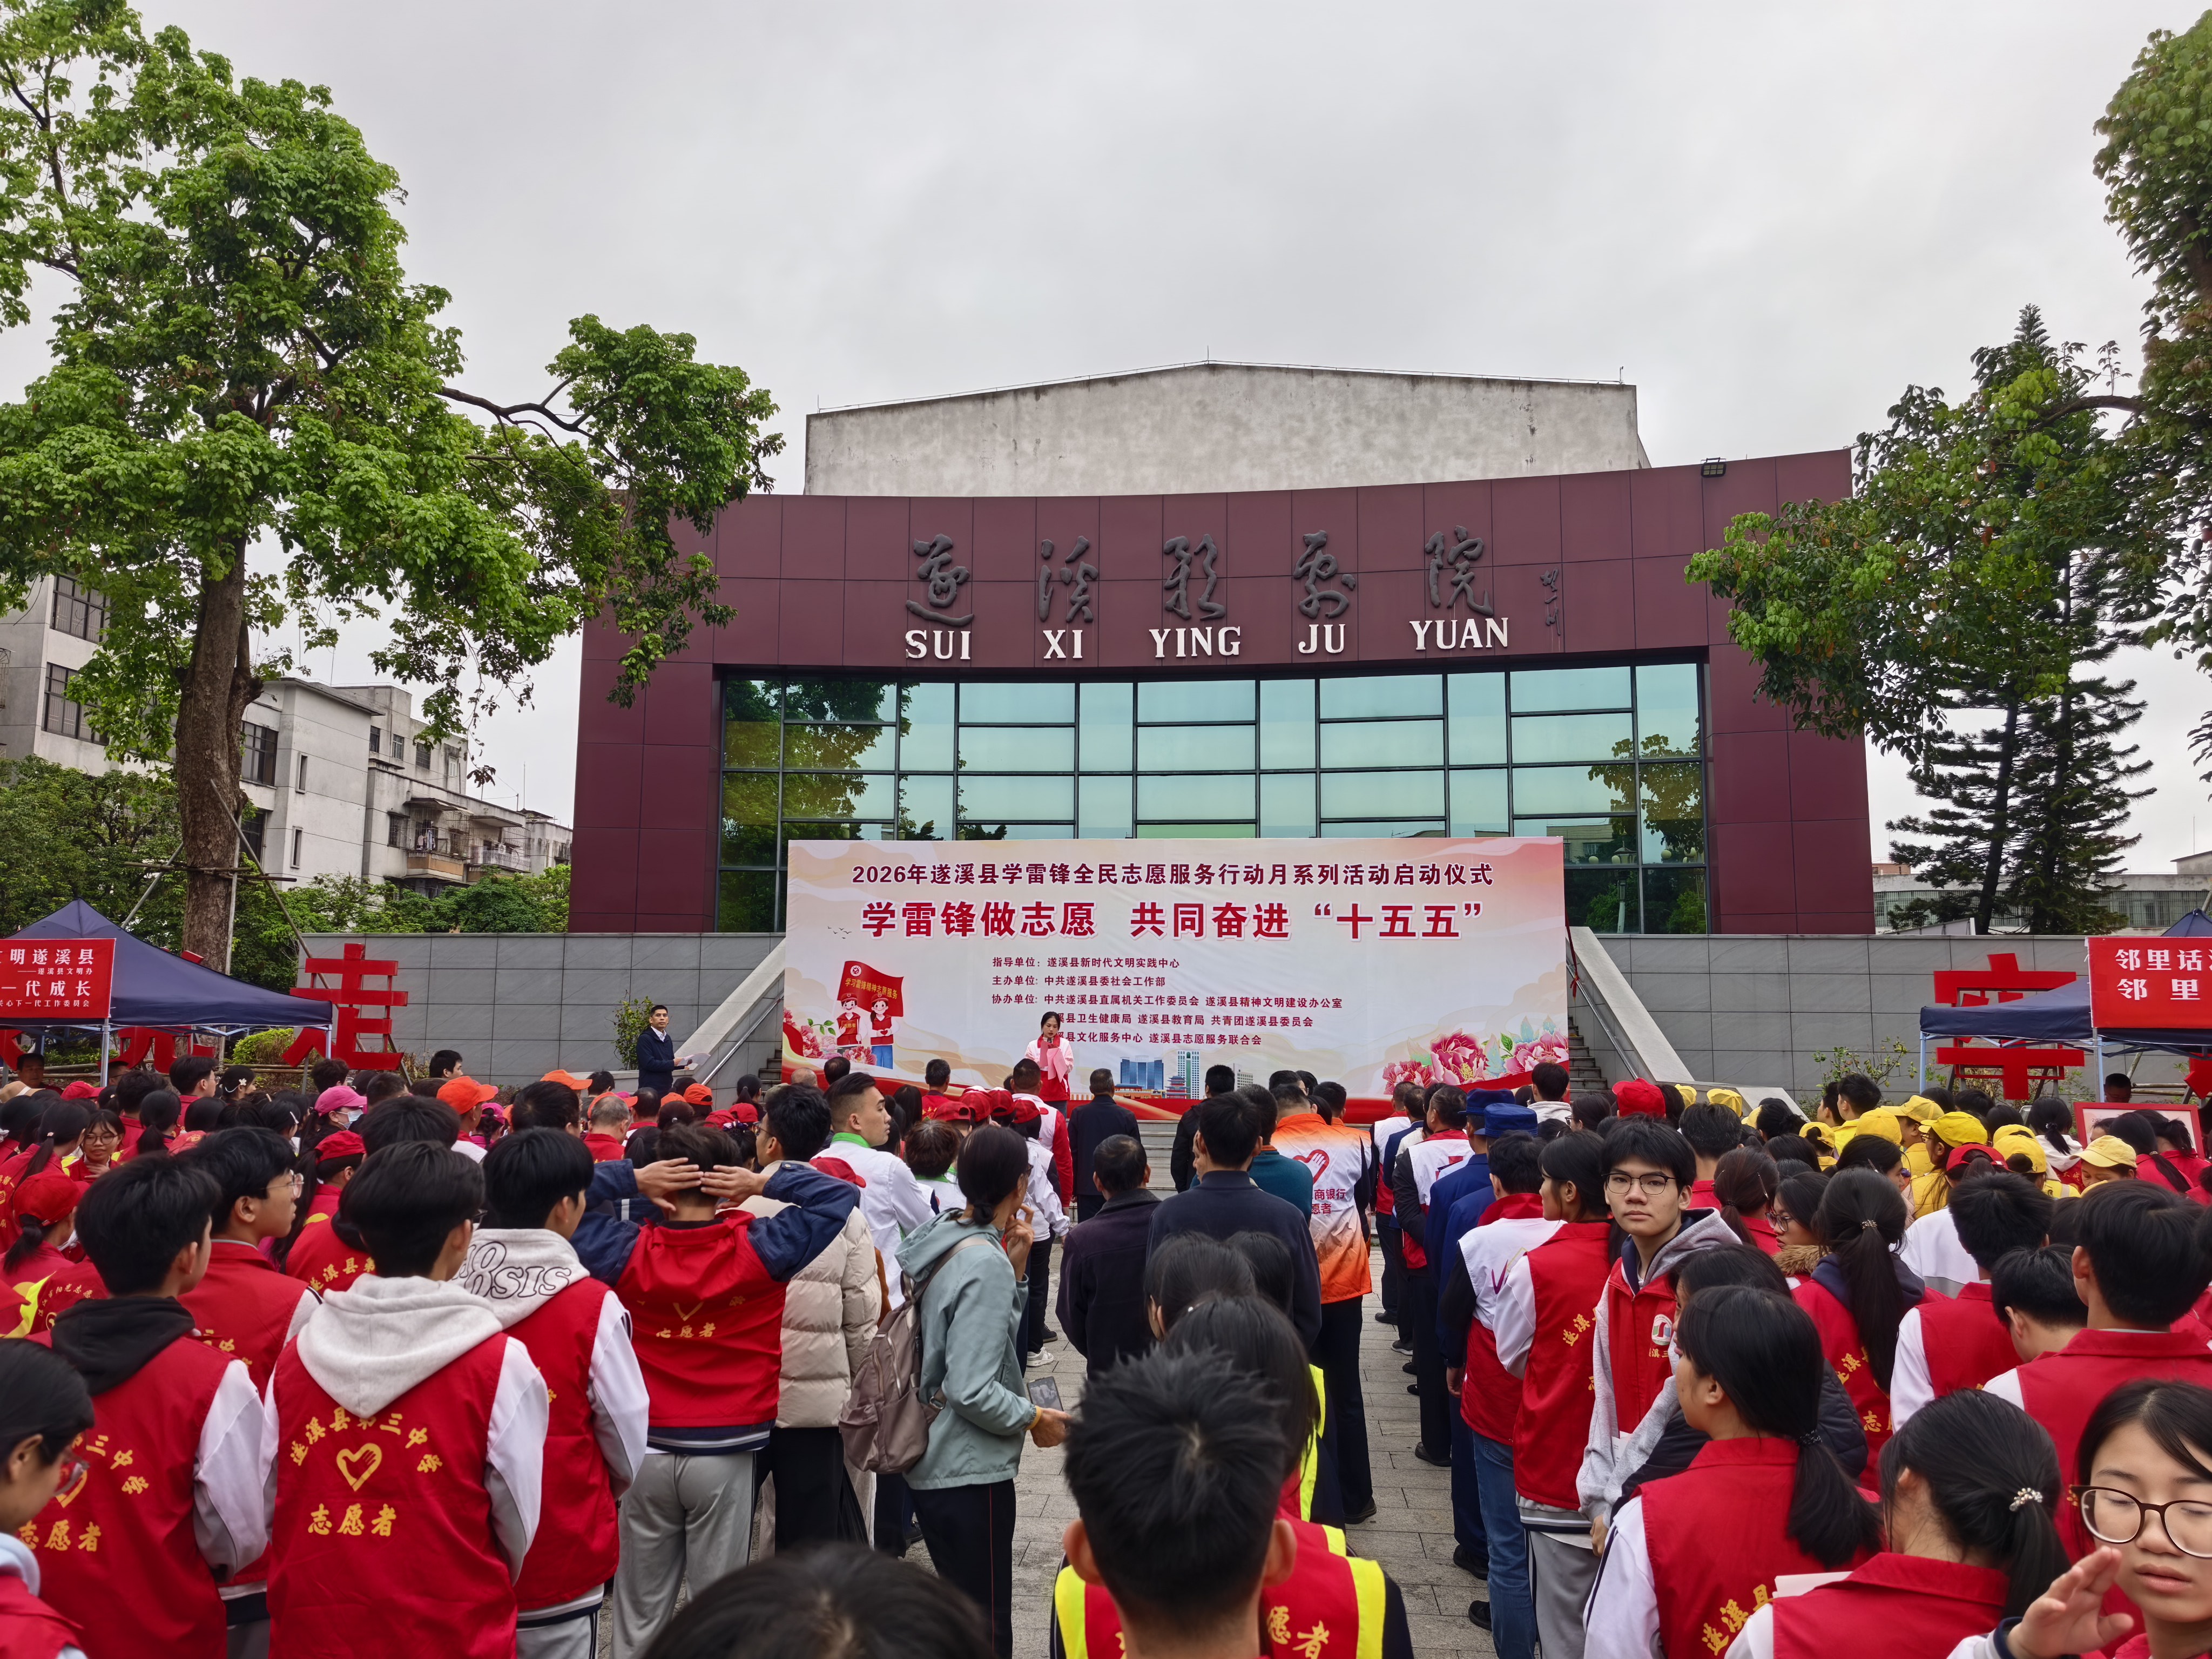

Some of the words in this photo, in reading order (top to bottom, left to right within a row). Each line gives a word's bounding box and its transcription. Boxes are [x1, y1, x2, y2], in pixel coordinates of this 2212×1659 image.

[906, 630, 972, 660] SUI
[1043, 630, 1083, 659] XI
[1149, 626, 1241, 658] YING
[1299, 624, 1346, 655] JU
[1410, 617, 1509, 651] YUAN
[852, 862, 1493, 885] 2026年遂溪县学雷锋全民志愿服务行动月系列活动启动仪式
[862, 901, 1096, 938] 学雷锋做志愿
[2115, 949, 2212, 972] 邻里话
[1205, 996, 1343, 1009] 遂溪县精神文明建设办公室
[1138, 1014, 1204, 1026] 遂溪县教育局
[1211, 1015, 1313, 1028] 共青团遂溪县委员会
[1149, 1033, 1262, 1046] 遂溪县志愿服务联合会
[1312, 1189, 1347, 1200] 商银行
[1563, 1307, 1596, 1346] 遂溪
[308, 1503, 397, 1537] 志愿者
[18, 1519, 102, 1552] 志愿者
